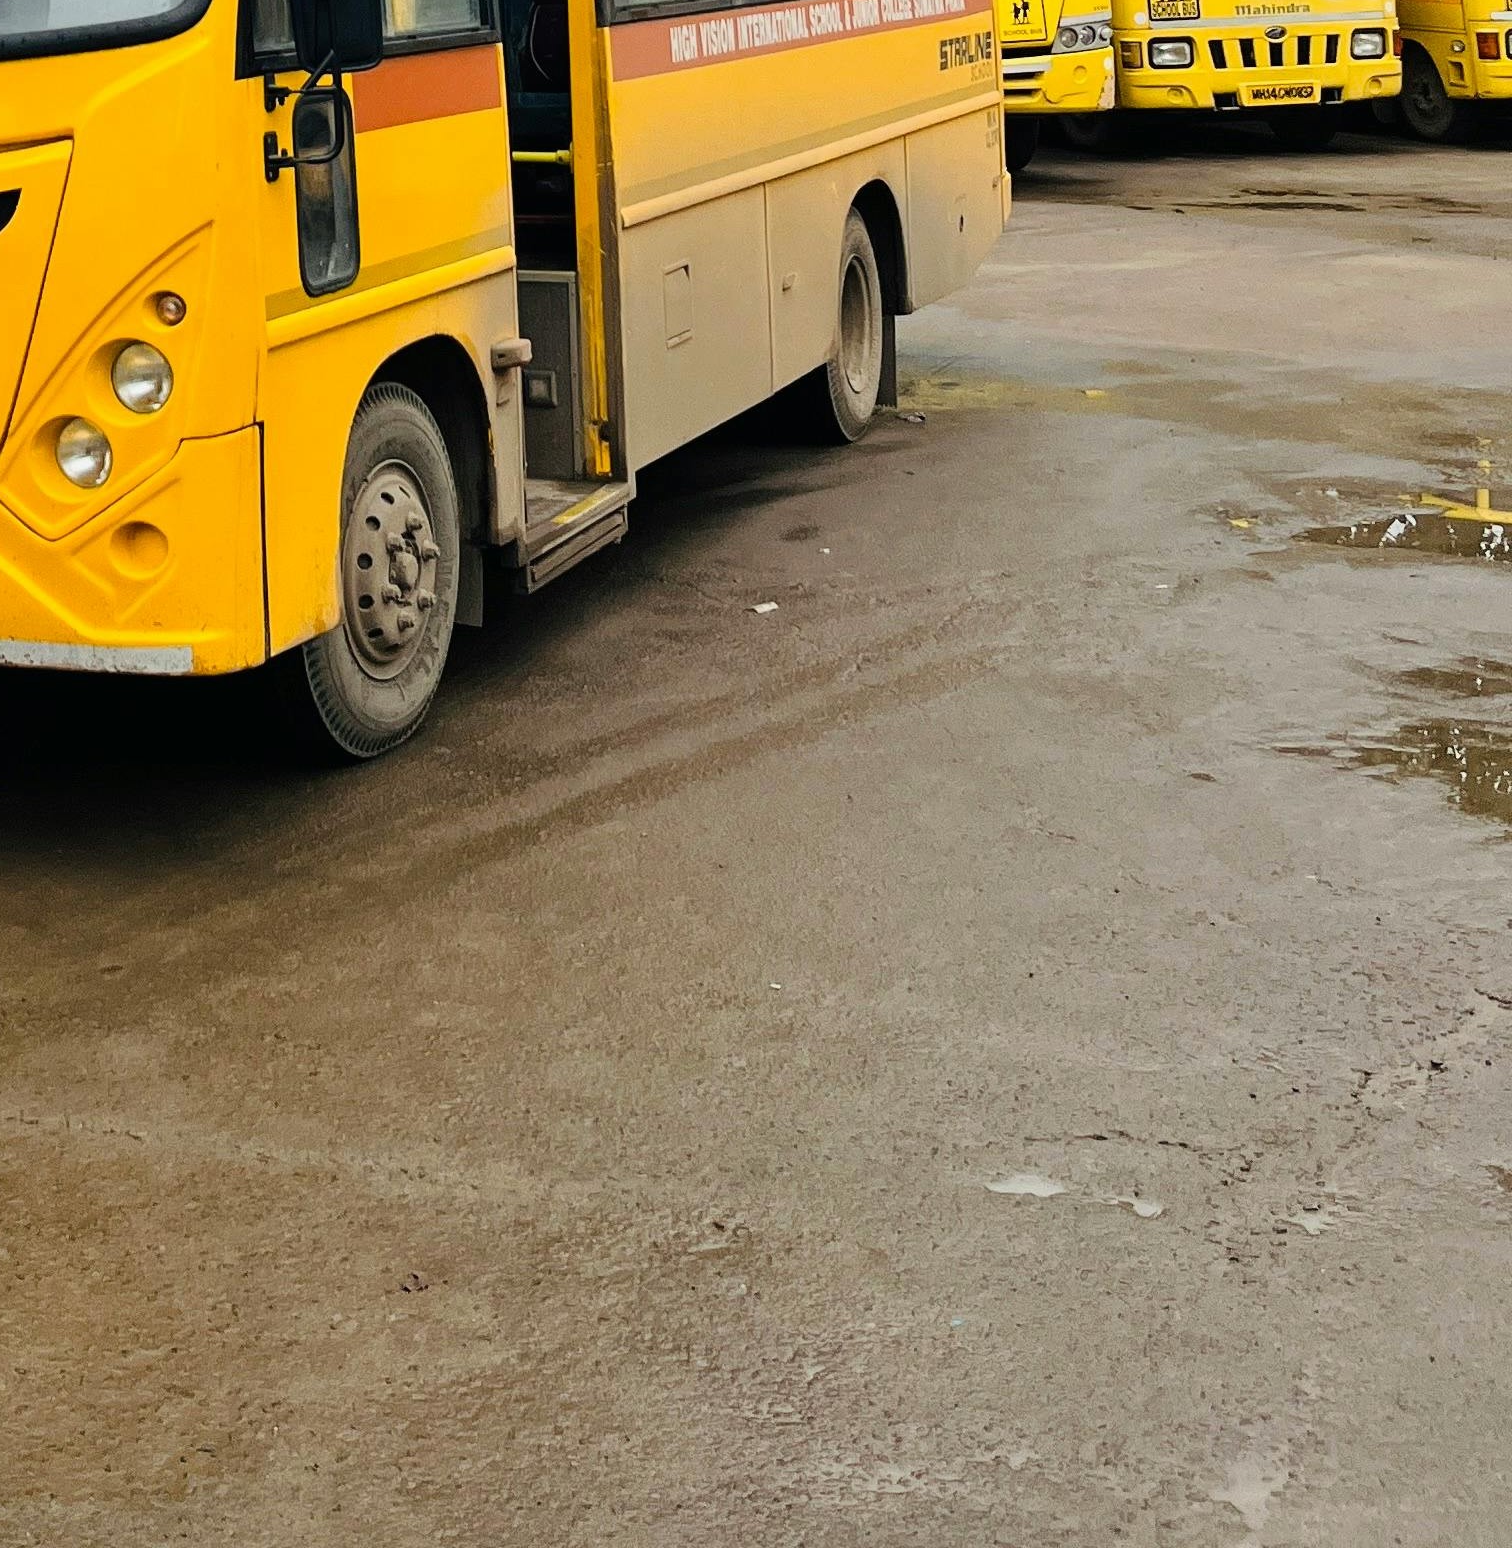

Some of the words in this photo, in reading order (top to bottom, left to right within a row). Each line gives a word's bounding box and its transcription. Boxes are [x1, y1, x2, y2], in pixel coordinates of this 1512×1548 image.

[1234, 2, 1311, 16] Mahindra
[669, 23, 699, 63] HIGH
[699, 17, 736, 57] VISION
[736, 6, 809, 50] INTERNATIONAL
[809, 1, 844, 37] SCHOOL
[940, 31, 992, 71] STARLINE
